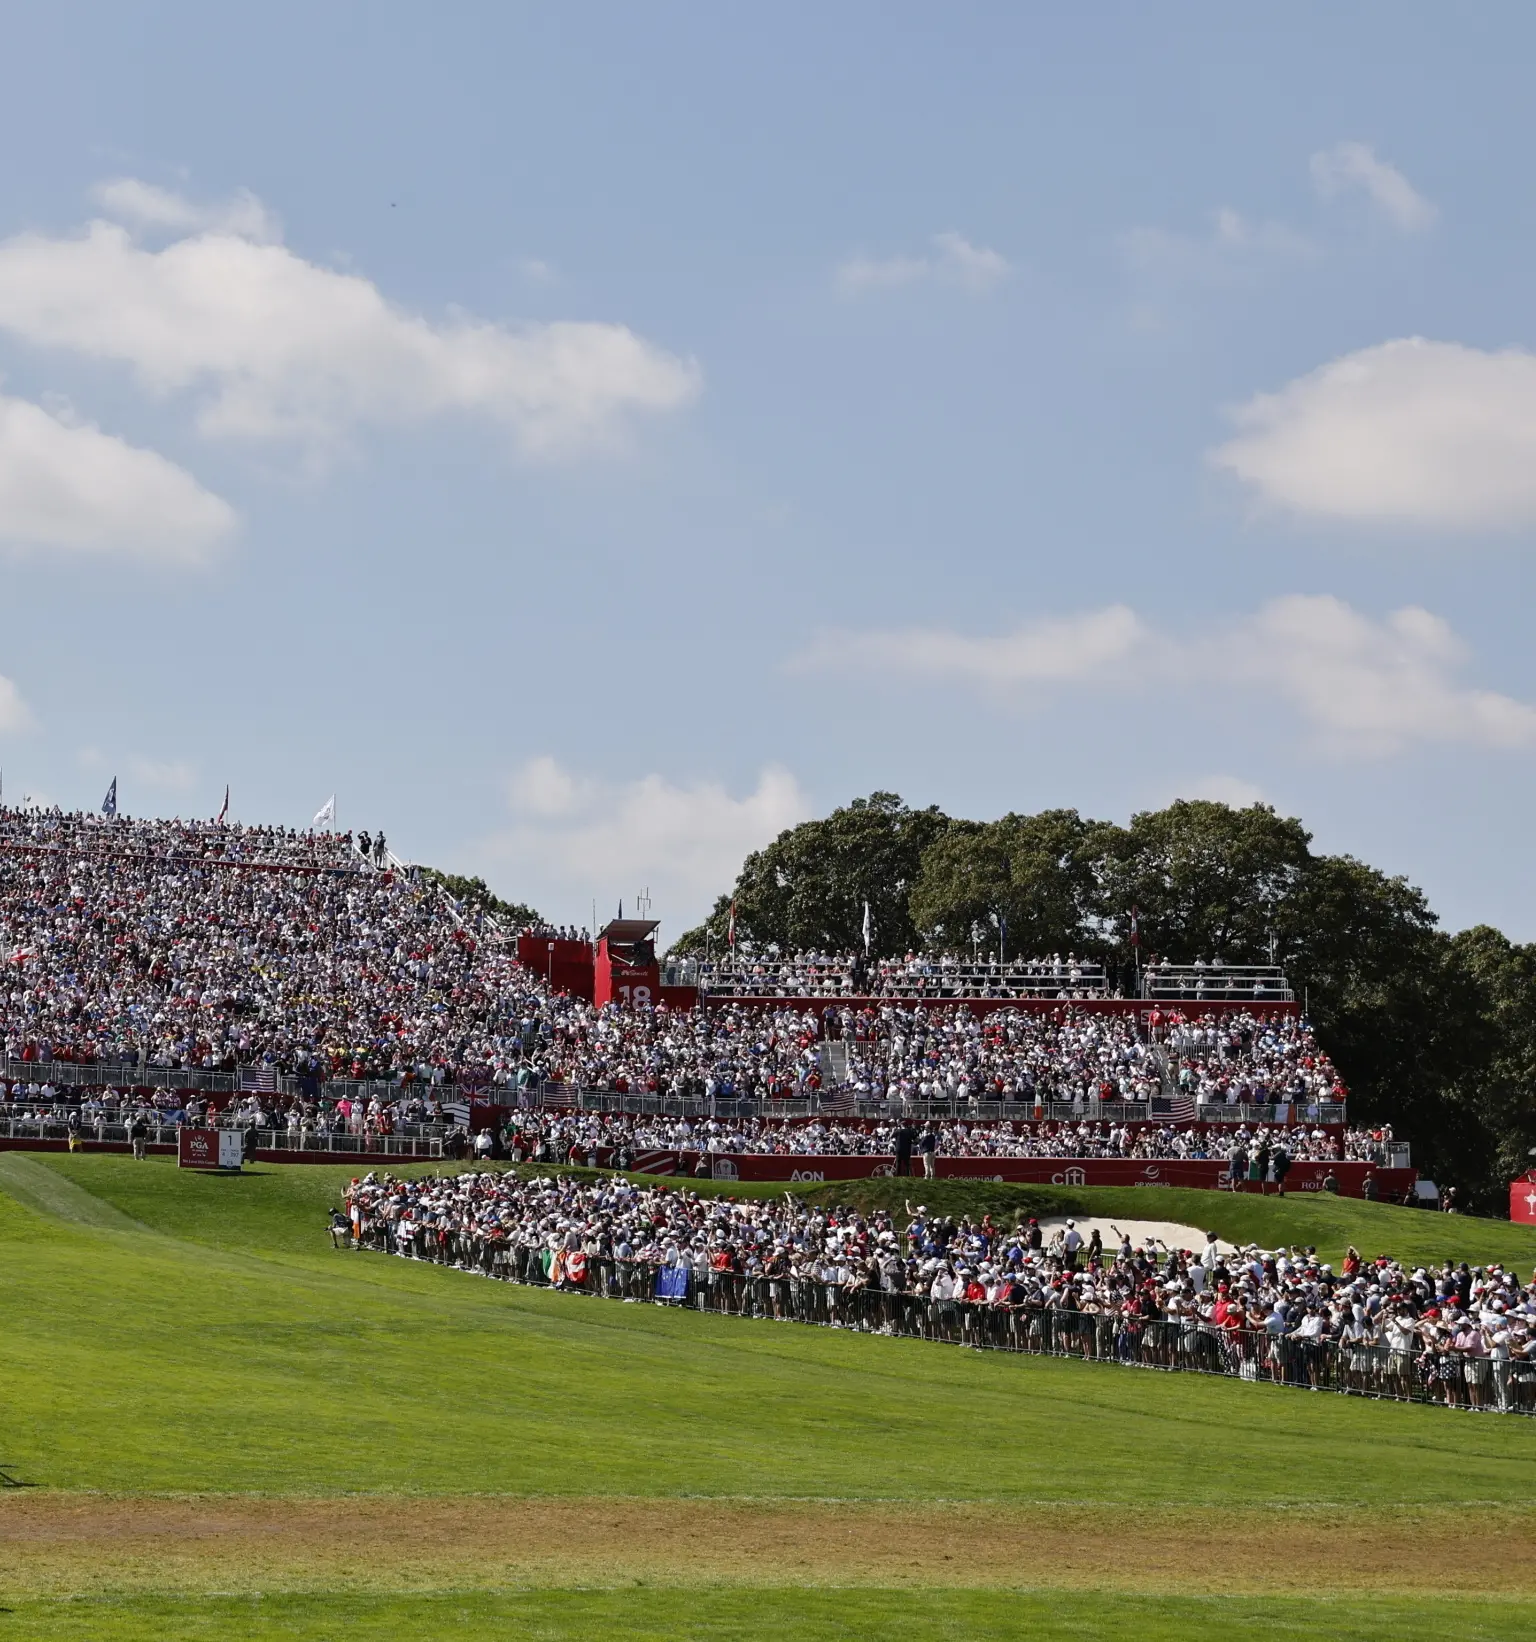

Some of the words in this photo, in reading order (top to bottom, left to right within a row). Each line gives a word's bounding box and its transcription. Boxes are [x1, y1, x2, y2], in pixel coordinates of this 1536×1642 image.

[618, 985, 651, 1009] 18
[190, 1141, 209, 1149] PGA
[228, 1135, 232, 1146] 1
[790, 1168, 825, 1182] AON
[1051, 1166, 1086, 1186] citi
[1301, 1181, 1322, 1190] ROL
